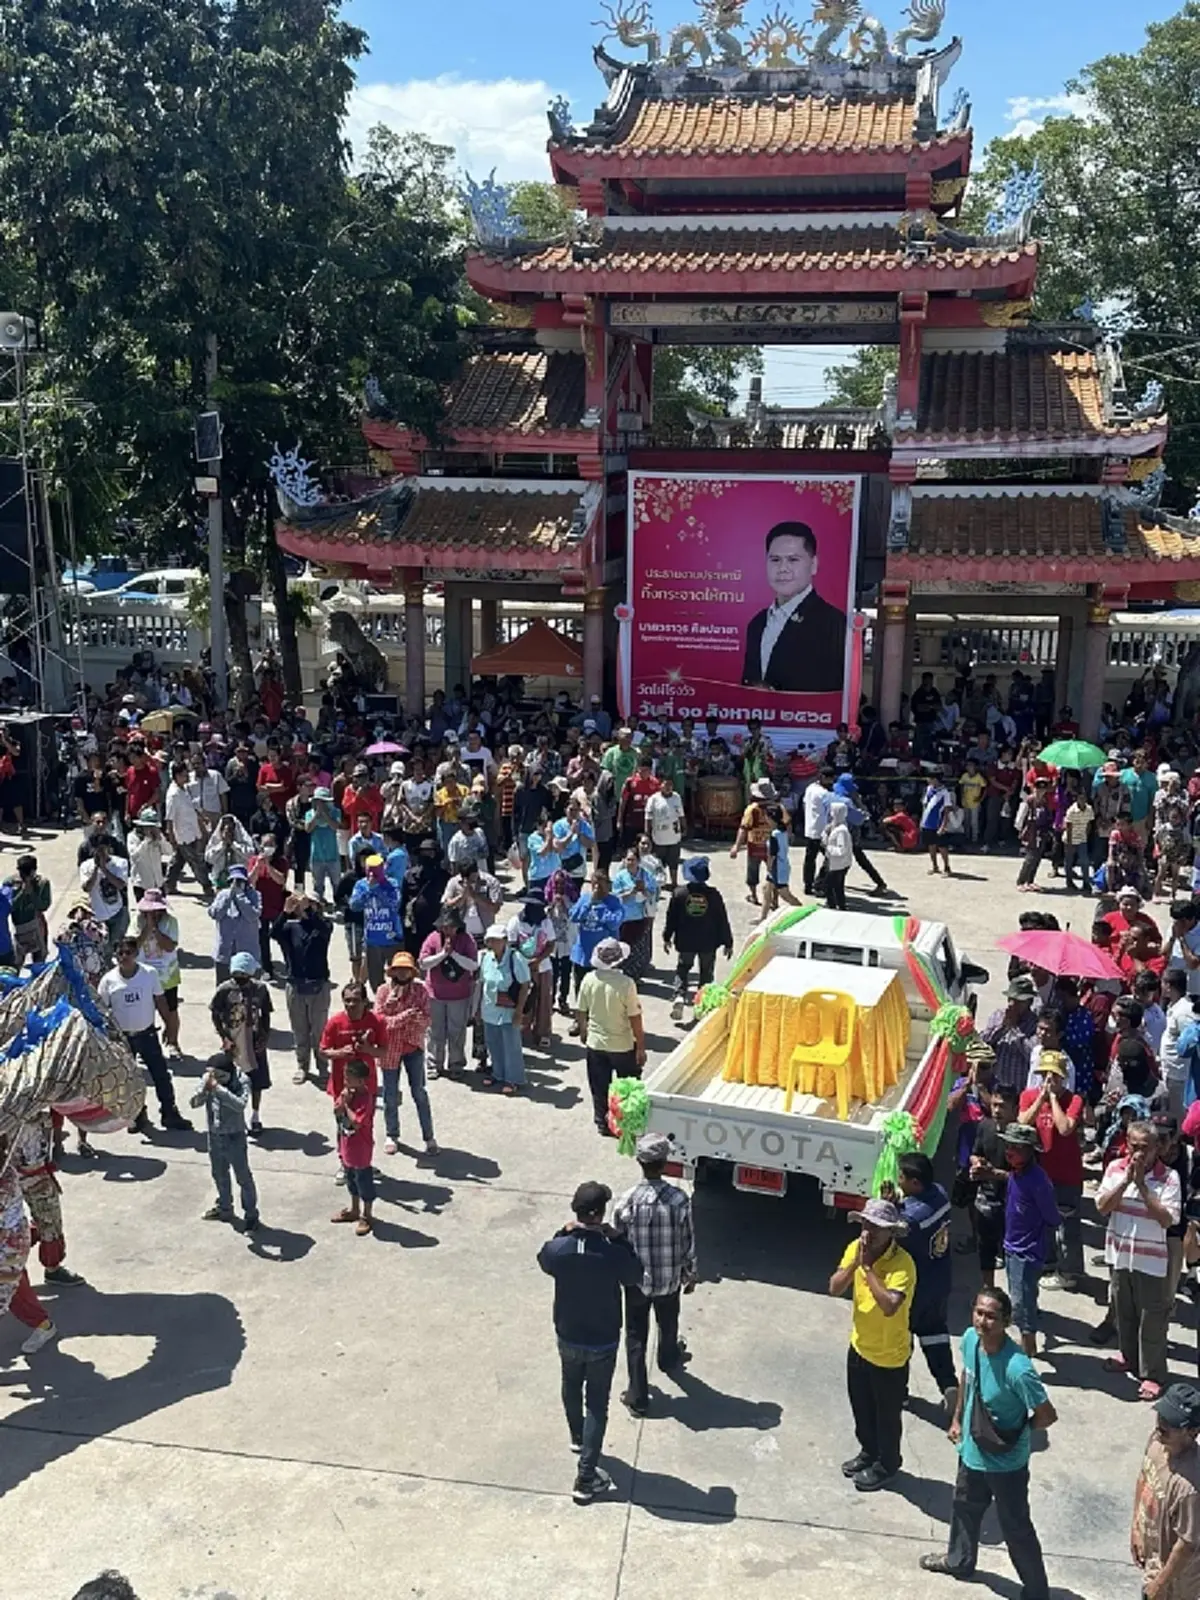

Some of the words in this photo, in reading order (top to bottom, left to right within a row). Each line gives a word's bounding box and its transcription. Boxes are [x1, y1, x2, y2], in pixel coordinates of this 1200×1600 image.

[641, 583, 745, 602] ทิ้งกระจาดให้ทาน
[638, 697, 674, 717] วันที่
[678, 707, 703, 718] ๑๐
[706, 703, 776, 721] สิงหาคม
[124, 991, 141, 1003] USA
[677, 1116, 840, 1166] TOYOTA
